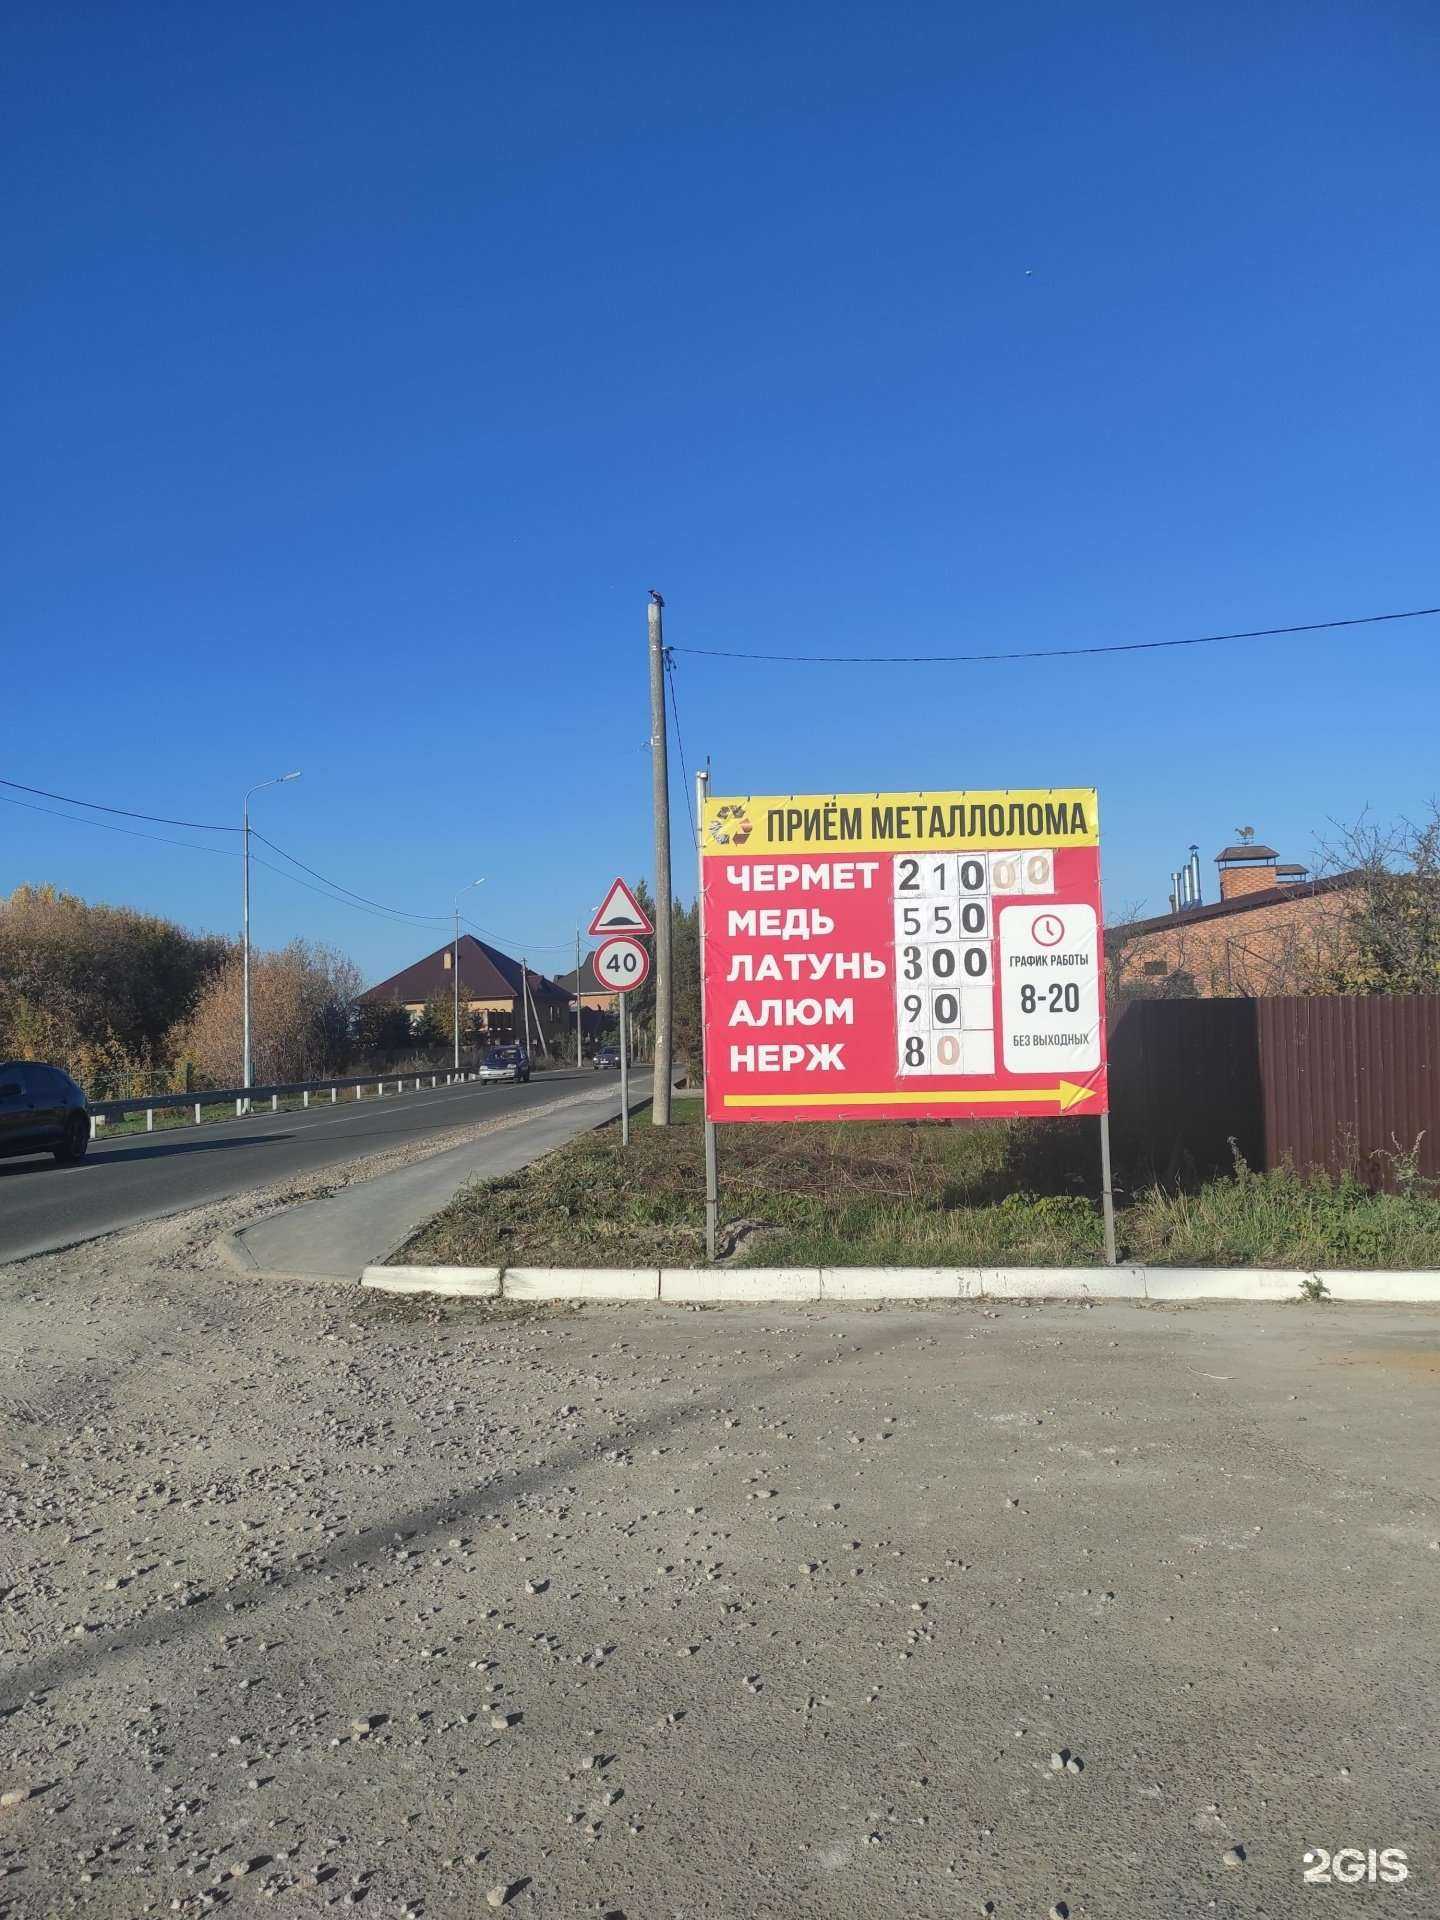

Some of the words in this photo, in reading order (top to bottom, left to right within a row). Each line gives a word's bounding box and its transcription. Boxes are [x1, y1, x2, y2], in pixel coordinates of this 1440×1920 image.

[767, 803, 862, 842] ПРИЁМ
[871, 802, 1088, 839] МЕТАЛЛОЛОМА
[726, 862, 879, 891] ЧЕРМЕТ
[728, 909, 835, 941] МЕДЬ
[903, 903, 985, 935] 550
[606, 953, 637, 973] 40
[726, 953, 887, 982] ЛАТУНЬ
[903, 946, 987, 980] 300
[1009, 955, 1048, 967] ГРАФИК
[1050, 954, 1089, 967] РАБОТЫ
[728, 998, 854, 1027] АЛЮМ
[903, 993, 959, 1024] 90
[1020, 983, 1080, 1014] 8-20
[730, 1044, 845, 1072] НЕРЖ
[904, 1035, 960, 1067] 80
[1013, 1035, 1031, 1047] БЕЗ
[1033, 1034, 1089, 1046] ВЫХОДНЫХ
